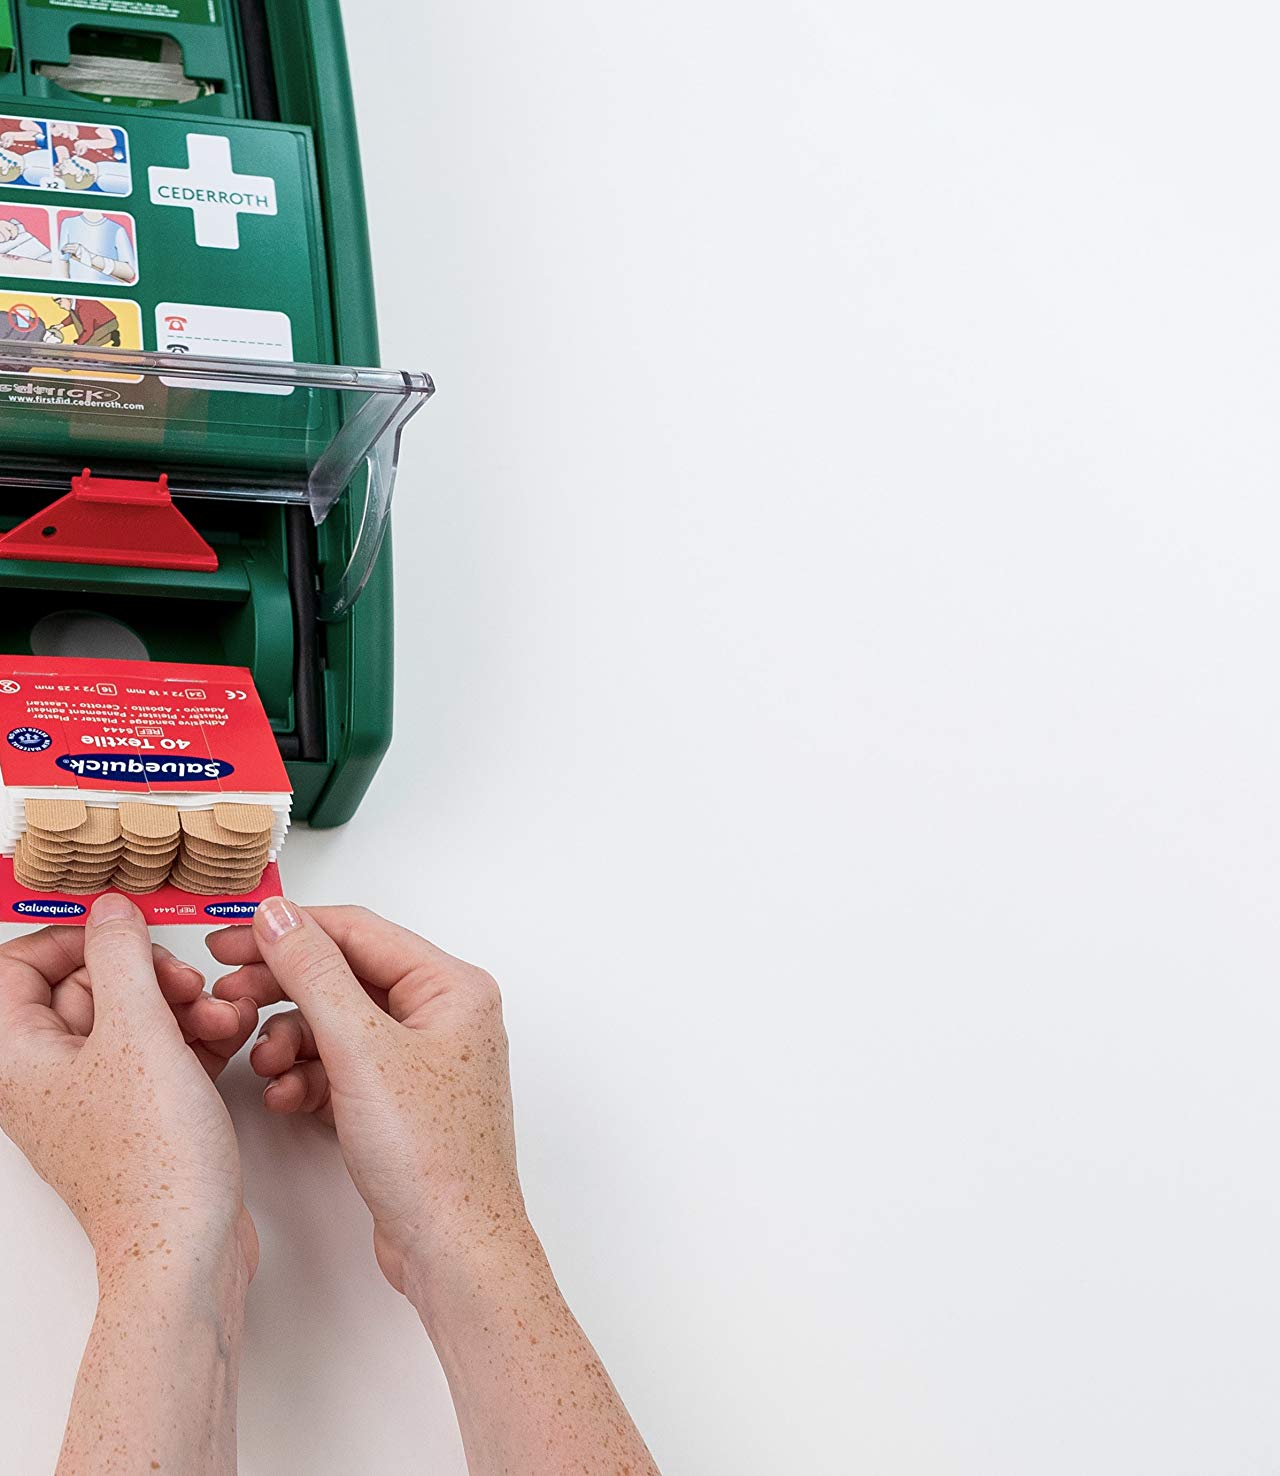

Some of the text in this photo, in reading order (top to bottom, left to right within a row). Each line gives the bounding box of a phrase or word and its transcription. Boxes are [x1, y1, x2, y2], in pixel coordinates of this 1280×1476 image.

[158, 186, 269, 208] CEDERROTH
[80, 702, 120, 710] Cerotto
[68, 708, 127, 717] Pansement
[33, 714, 70, 722] Plaster
[103, 726, 134, 734] 6444
[80, 735, 191, 750] 40 Textile
[17, 902, 81, 914] Salvequick
